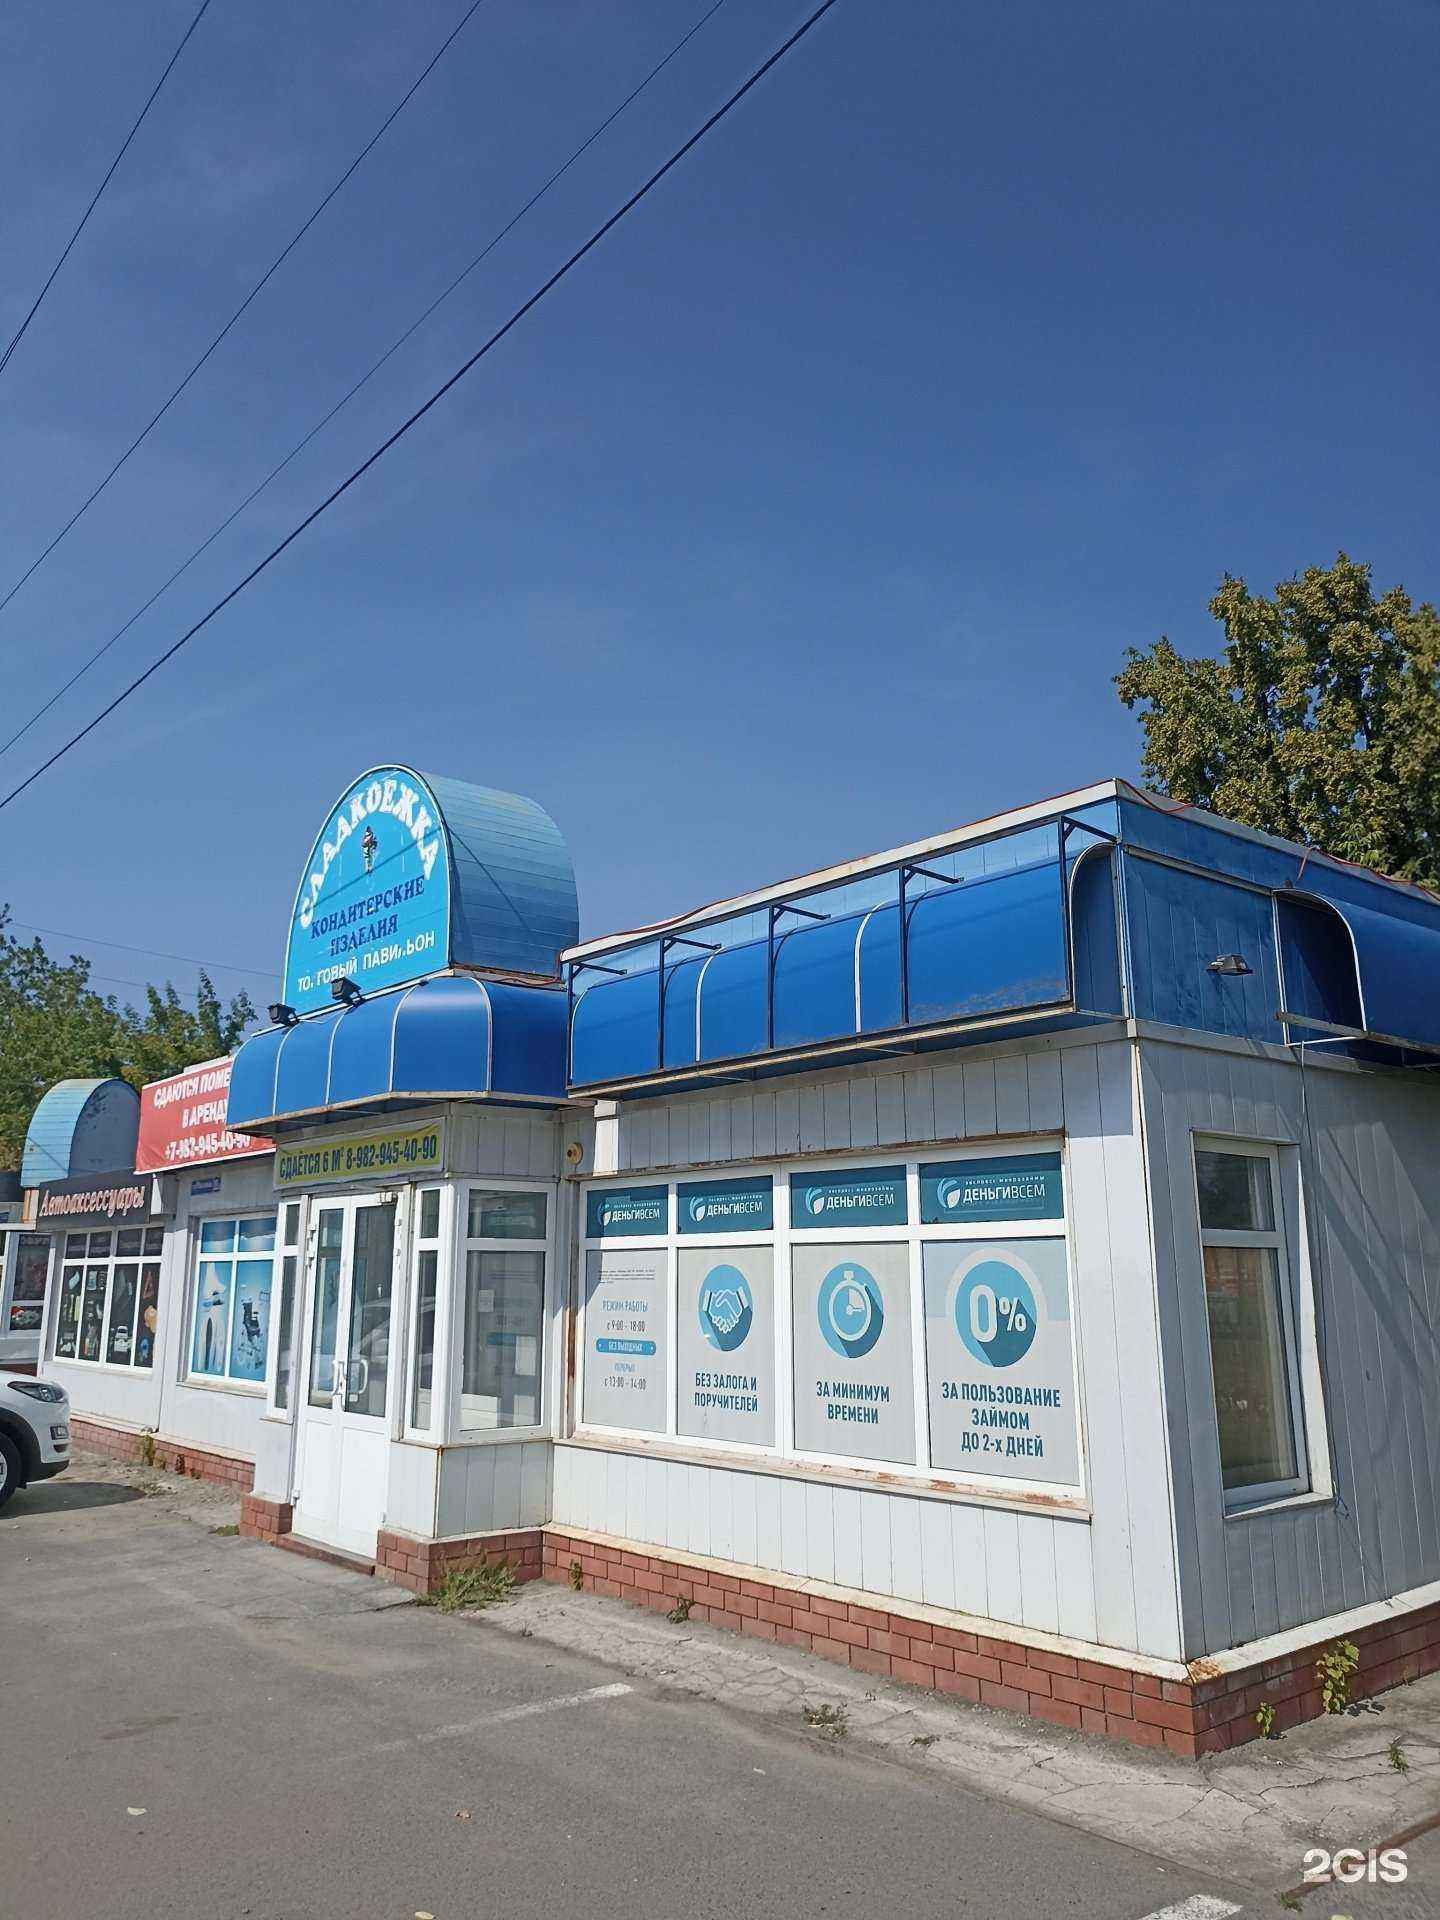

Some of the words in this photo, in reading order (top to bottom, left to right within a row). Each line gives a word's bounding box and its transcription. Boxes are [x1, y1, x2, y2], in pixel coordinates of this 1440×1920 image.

[311, 875, 425, 939] КОНДИТЕРСКИЕ
[330, 914, 399, 957] ИЗДЕЛИЯ
[297, 956, 358, 993] ТОГОВЫЙ
[153, 1079, 199, 1109] СДАЮТСЯ
[346, 1134, 437, 1170] 8-982-945-40-90
[39, 1186, 145, 1218] Автоаксессуары
[969, 1284, 1027, 1343] 0%
[695, 1372, 711, 1388] БЕЗ
[713, 1374, 748, 1391] ЗАЛОГА
[750, 1376, 757, 1391] И
[816, 1381, 830, 1397] ЗА
[832, 1382, 890, 1402] МИНИМУМ
[941, 1382, 959, 1400] ЗА
[961, 1383, 1061, 1408] ПОЛЬЗОВАНИЕ
[694, 1392, 758, 1412] ПОРУЧИТЕЛЕЙ
[827, 1403, 879, 1424] ВРЕМЕНИ
[971, 1406, 1030, 1431] ЗАЙМОМ
[961, 1431, 979, 1452] ДО
[1005, 1435, 1044, 1458] ДНЕЙ
